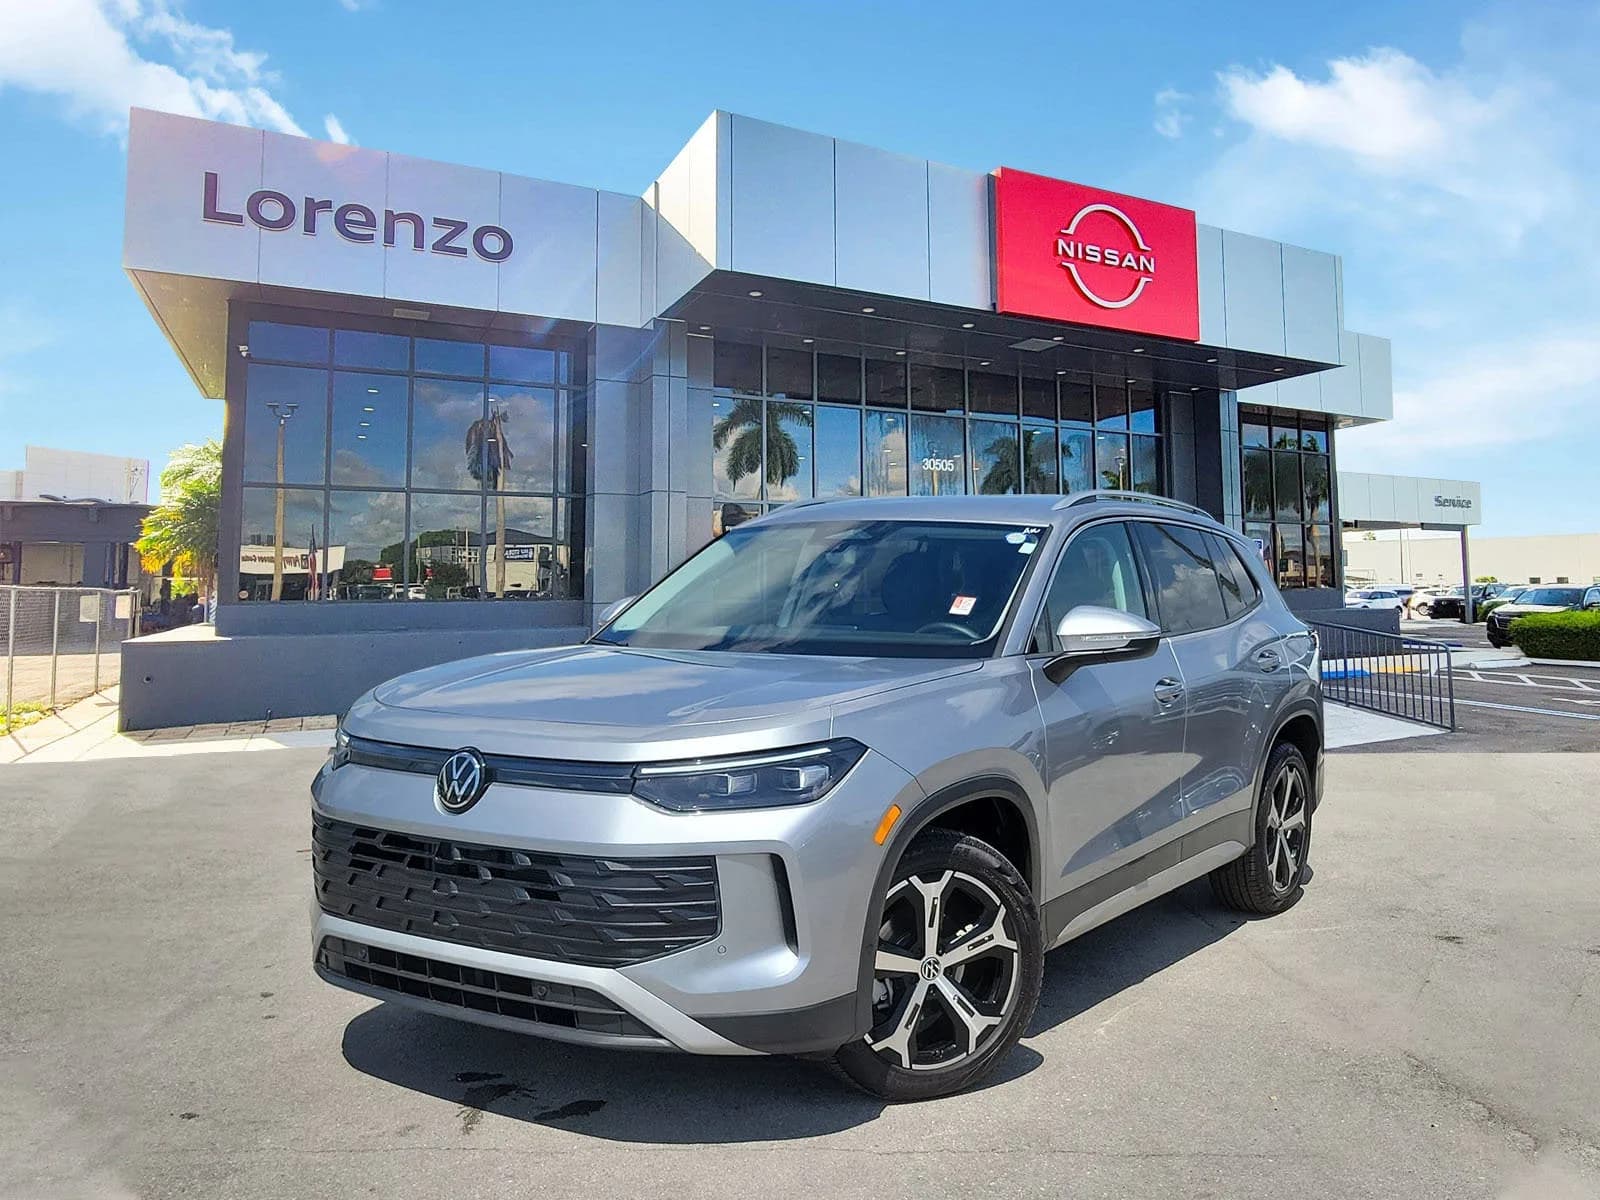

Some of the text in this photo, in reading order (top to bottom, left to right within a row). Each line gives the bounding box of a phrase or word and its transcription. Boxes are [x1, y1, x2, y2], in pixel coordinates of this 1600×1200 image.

[203, 171, 514, 262] Lorenzo
[1057, 238, 1155, 273] NISSAN
[922, 458, 954, 471] 30505
[1434, 495, 1472, 509] Service
